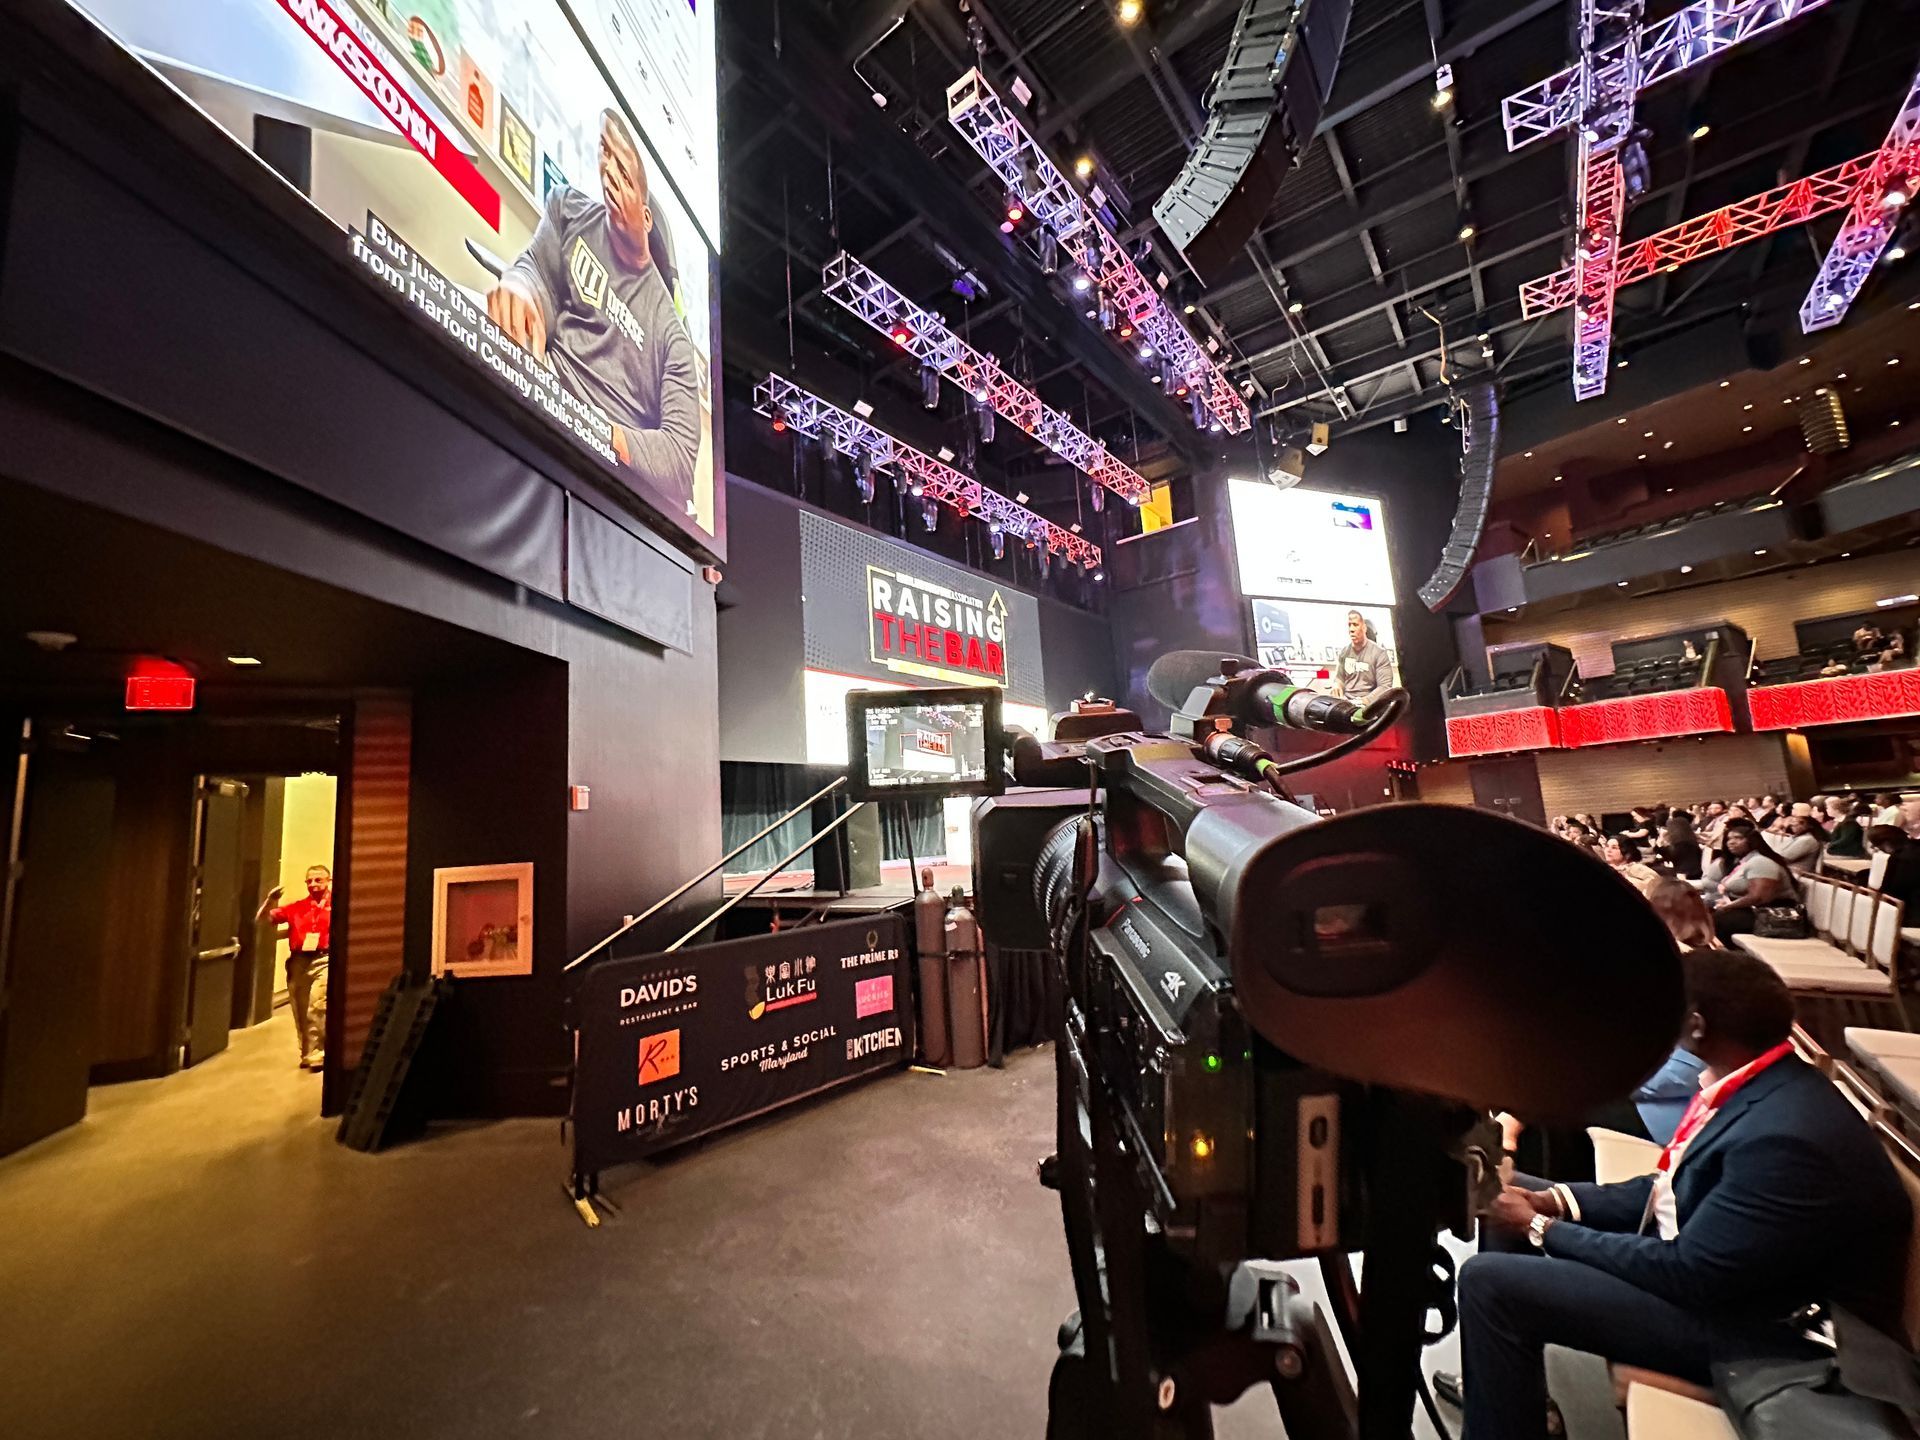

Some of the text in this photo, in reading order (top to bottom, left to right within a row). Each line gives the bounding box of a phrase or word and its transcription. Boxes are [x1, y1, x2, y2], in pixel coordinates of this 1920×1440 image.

[371, 218, 612, 441] But just the talent that's produced
[352, 235, 618, 466] from Harford County Public Schools.
[872, 577, 1003, 642] RAISING
[1121, 917, 1150, 958] Panasonic
[840, 955, 859, 969] THE
[860, 950, 886, 965] PRIME
[620, 974, 697, 1008] DAVID'S
[1164, 971, 1186, 998] 4K
[619, 1007, 672, 1026] RESTAURANT
[683, 1001, 698, 1011] BAR
[721, 1025, 837, 1071] SPORTS & SOCIAL
[759, 1047, 808, 1072] Maryland
[618, 1086, 698, 1132] MORTY'S
